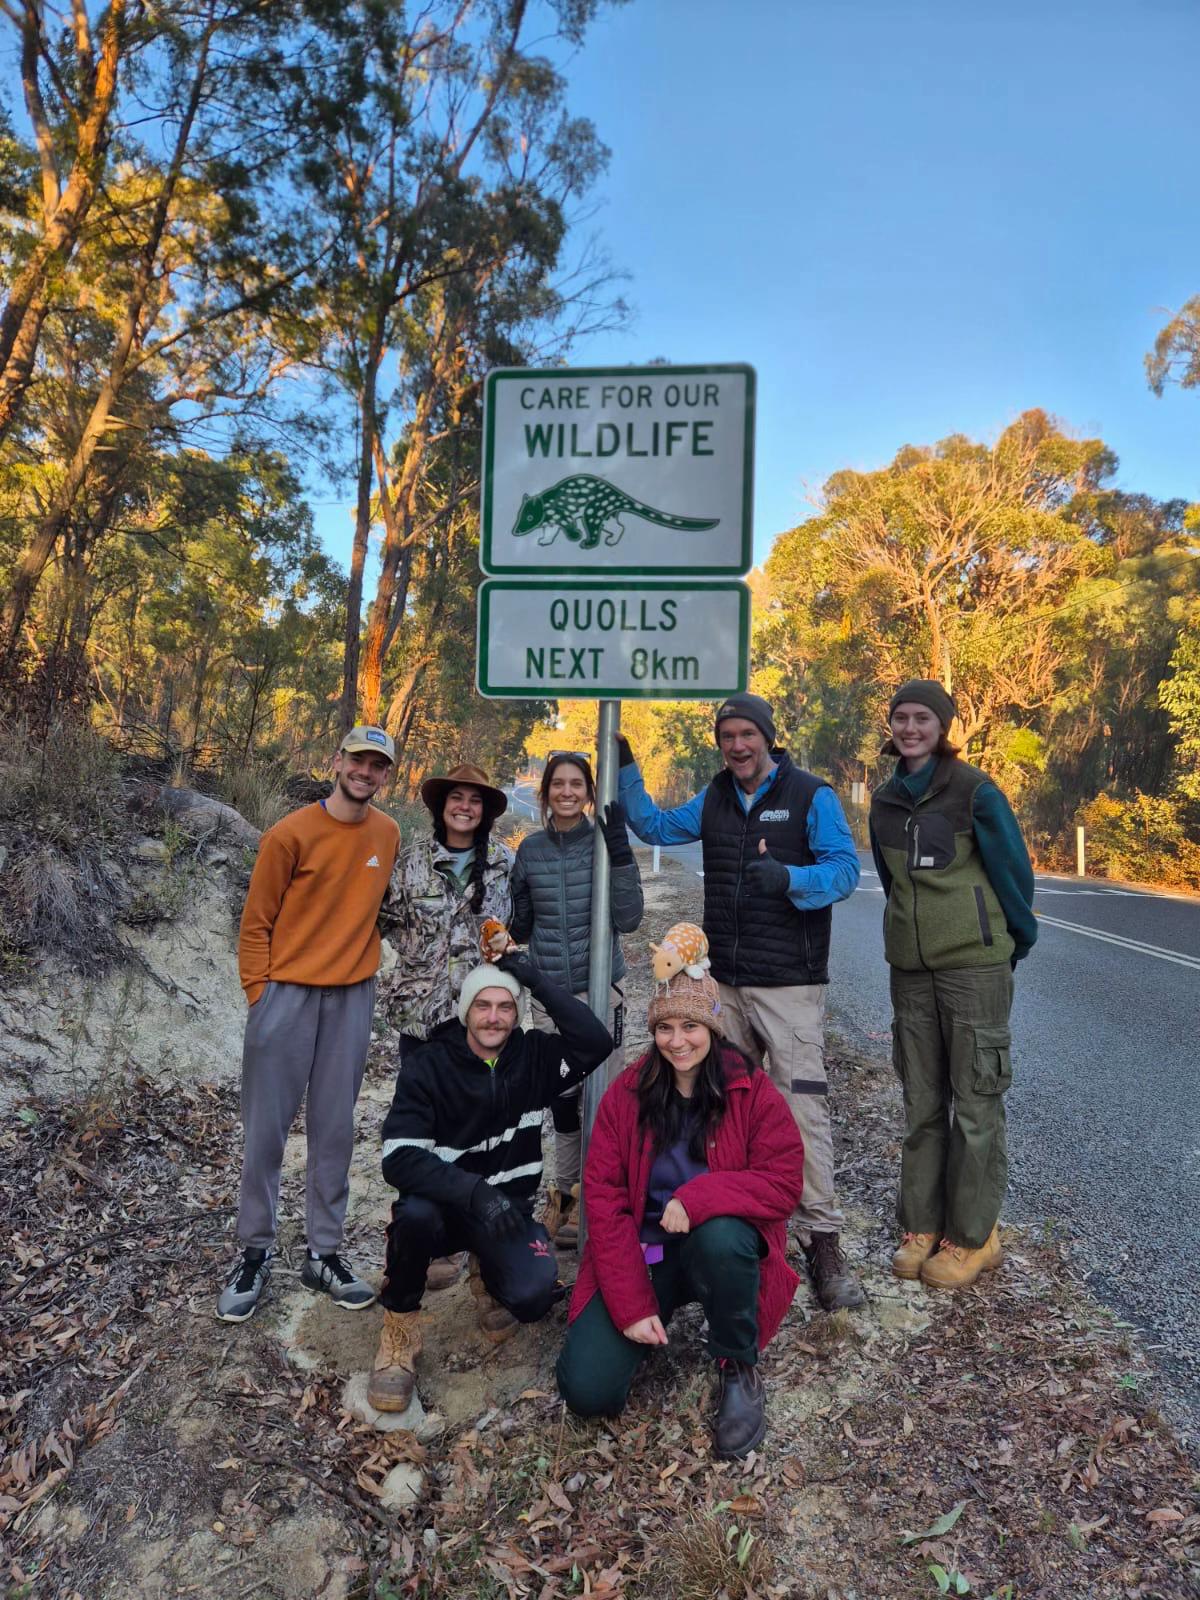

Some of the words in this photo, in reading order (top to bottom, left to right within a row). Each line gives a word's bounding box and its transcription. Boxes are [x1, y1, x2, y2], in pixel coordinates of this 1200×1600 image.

[520, 386, 590, 410] CARE
[600, 385, 653, 409] FOR
[664, 384, 720, 407] OUR
[523, 421, 715, 458] WILDLIFE
[550, 598, 678, 632] QUOLLS
[525, 647, 605, 679] NEXT
[630, 647, 700, 681] 8km
